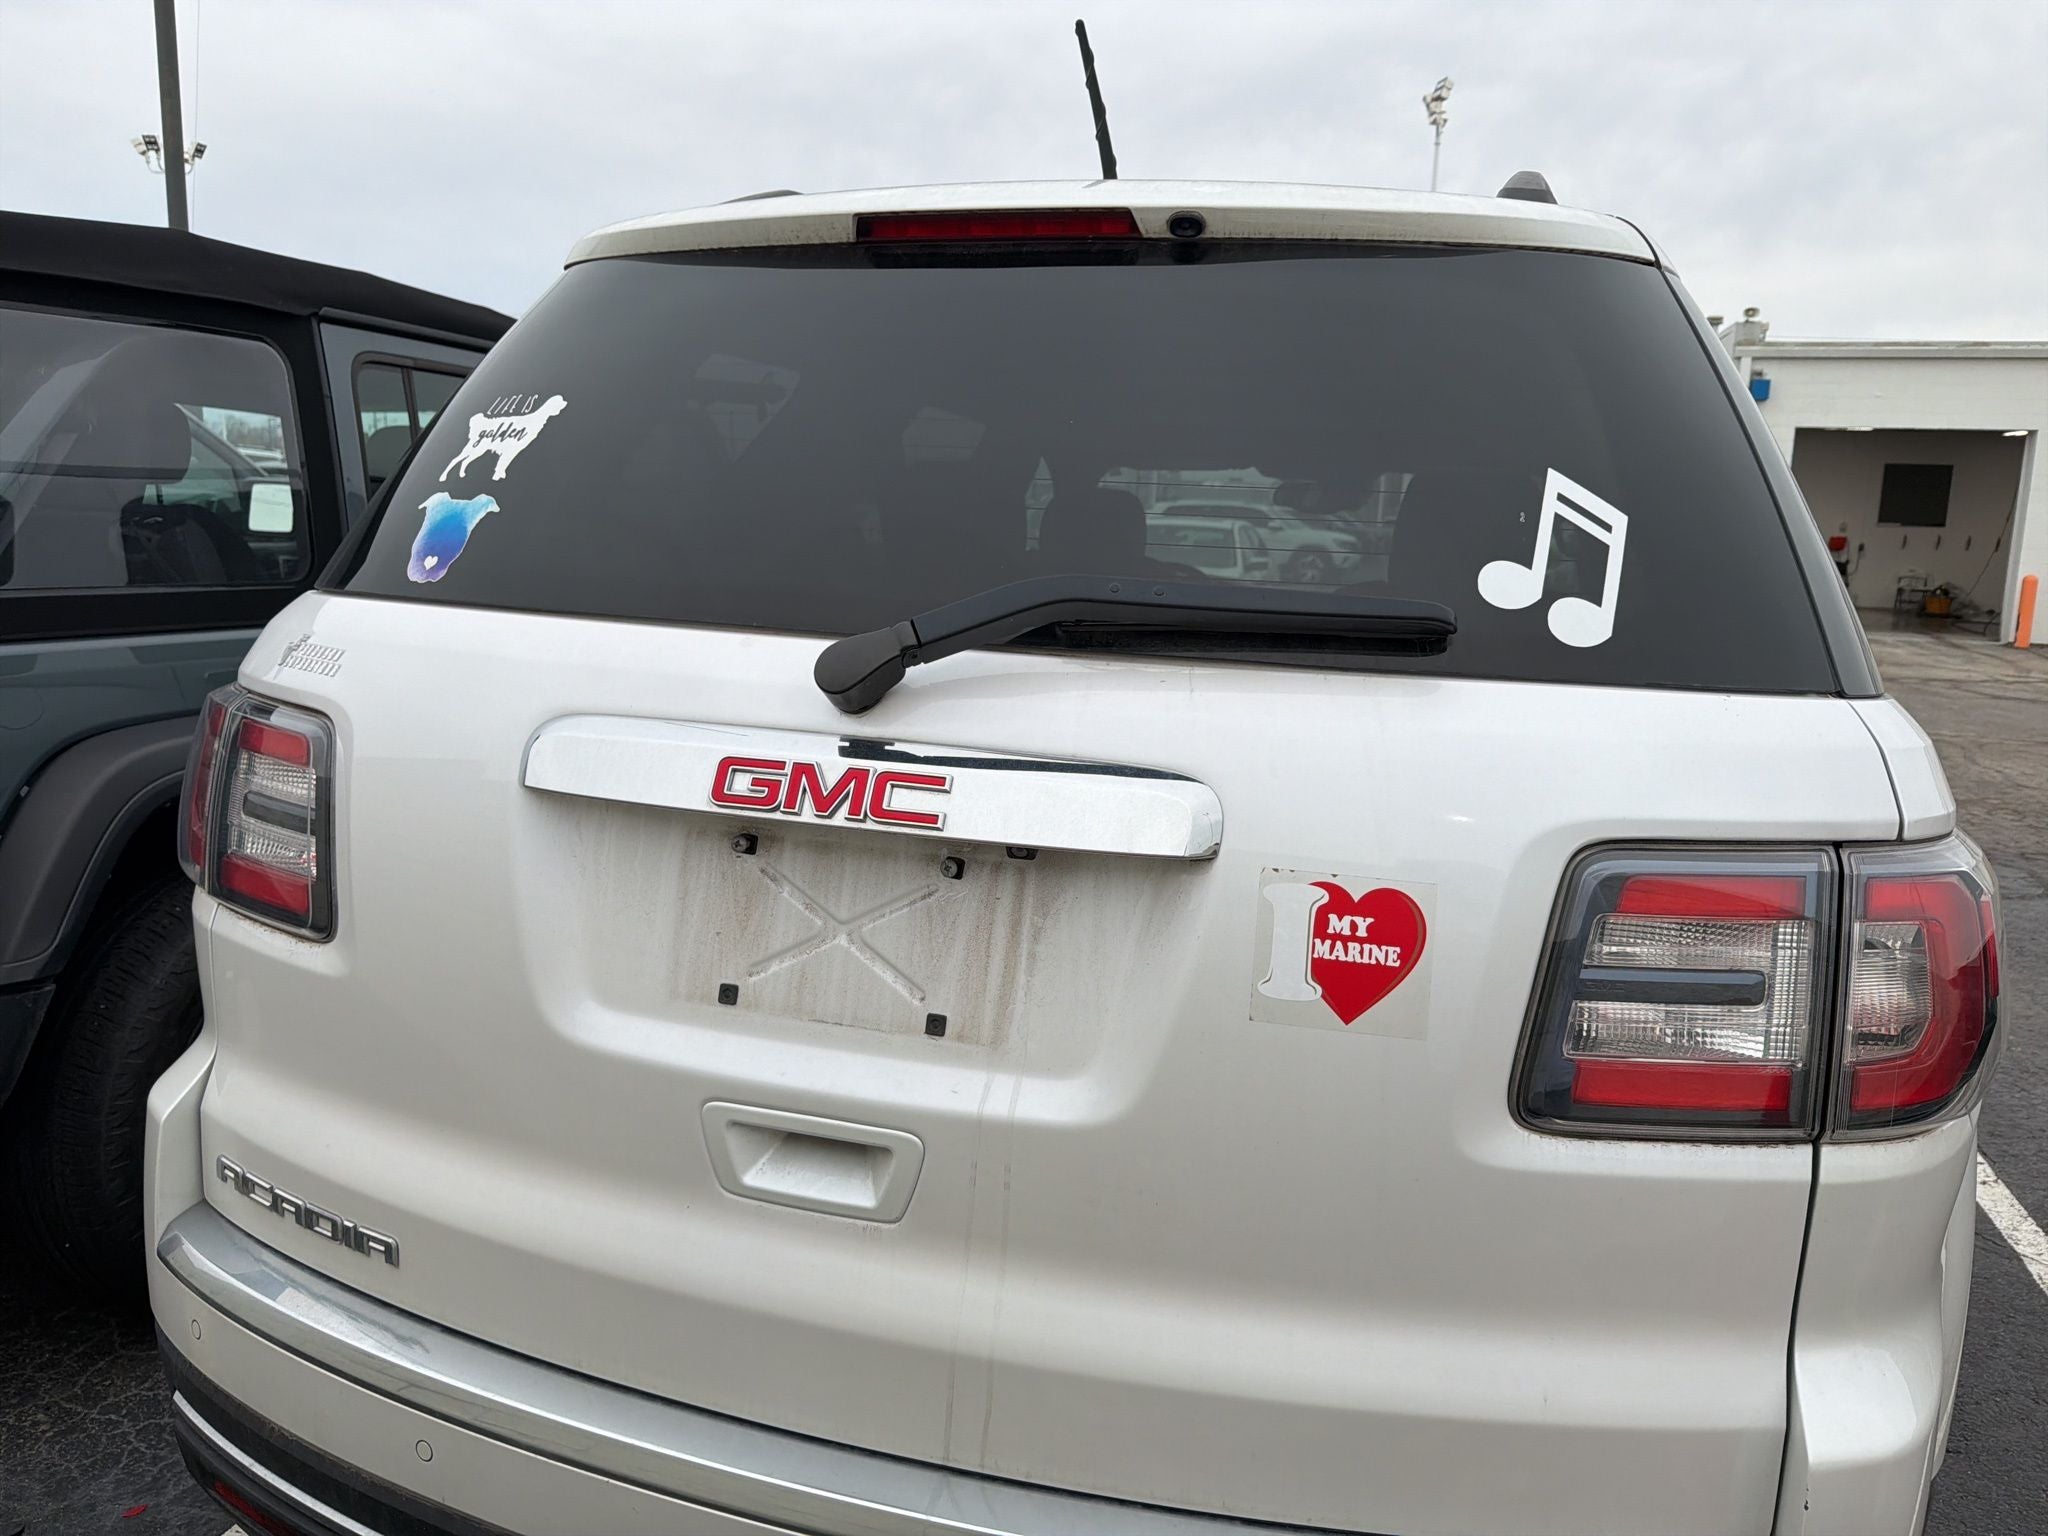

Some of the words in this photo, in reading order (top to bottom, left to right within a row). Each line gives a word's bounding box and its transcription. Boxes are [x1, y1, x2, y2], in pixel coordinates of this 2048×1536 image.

[487, 394, 523, 415] LIFE
[521, 394, 538, 413] IS
[472, 422, 528, 448] golden
[709, 756, 953, 831] GMC
[1327, 913, 1375, 937] MY
[1258, 883, 1330, 1001] I
[1313, 938, 1400, 967] MARINE
[216, 1154, 400, 1269] ACADIA
